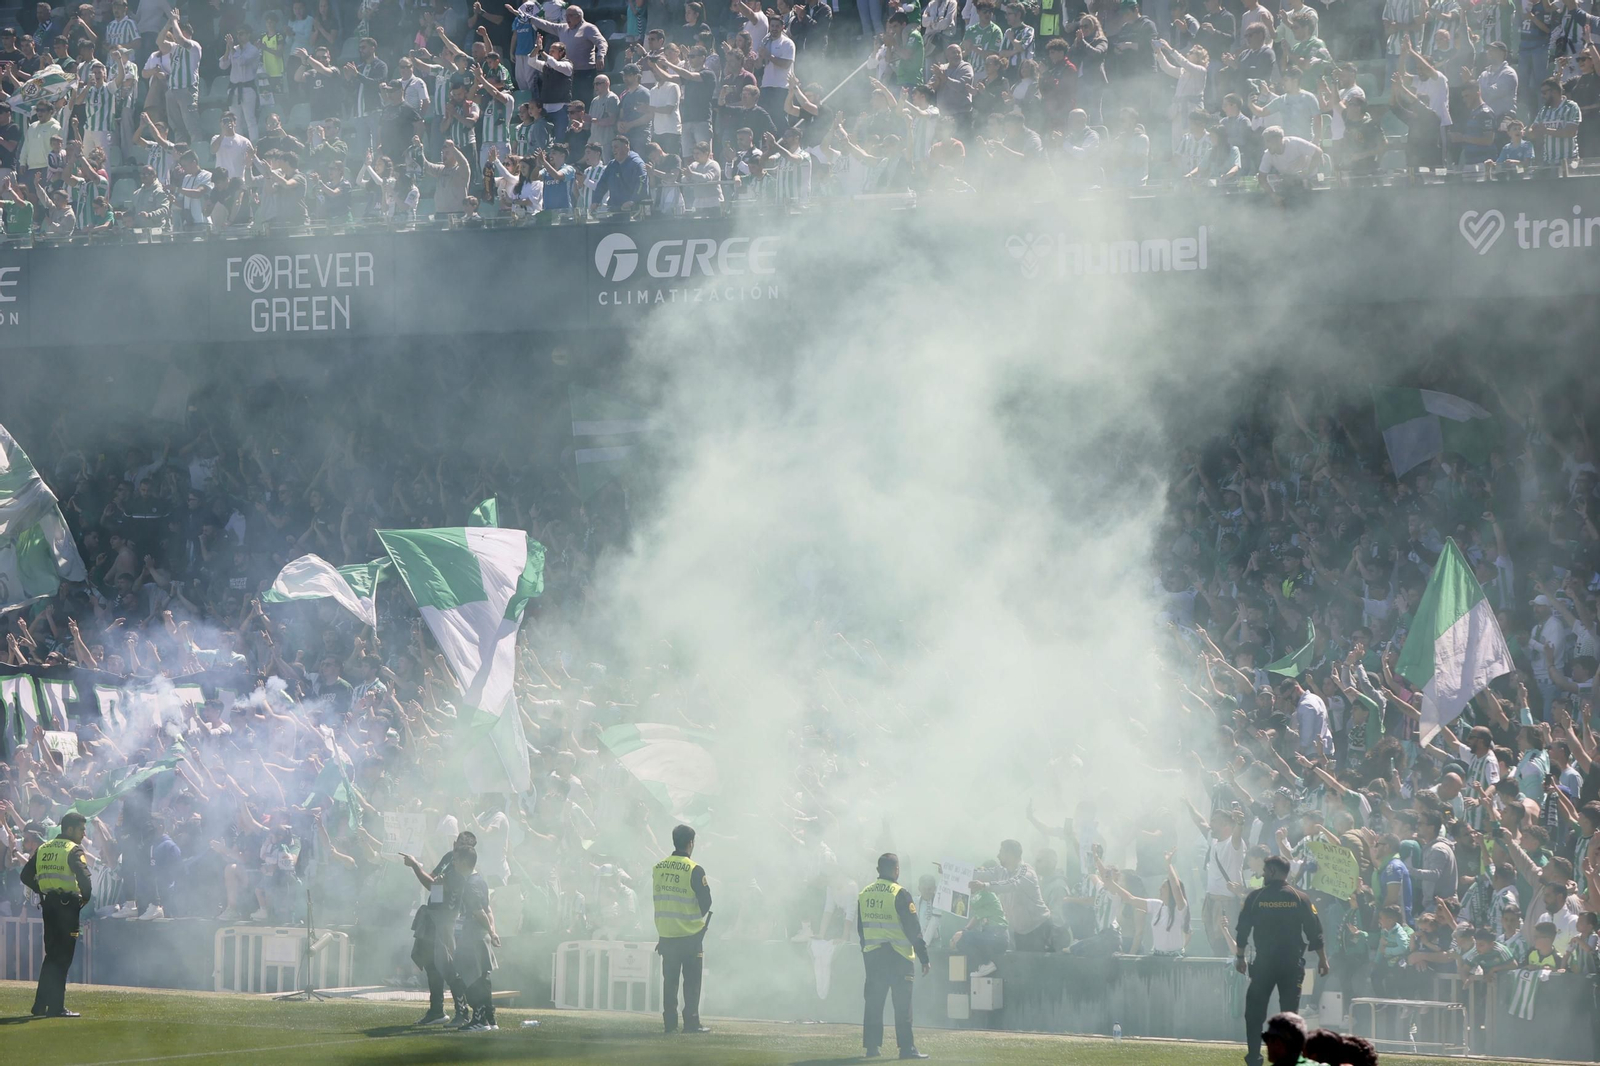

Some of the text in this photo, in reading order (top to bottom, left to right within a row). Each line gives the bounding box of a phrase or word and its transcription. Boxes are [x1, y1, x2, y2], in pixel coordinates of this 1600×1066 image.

[227, 251, 375, 294] FOREVER
[647, 235, 781, 279] GREE
[1058, 225, 1209, 278] hummel
[251, 294, 350, 333] GREEN
[598, 282, 780, 306] CLIMATIZACIÓN
